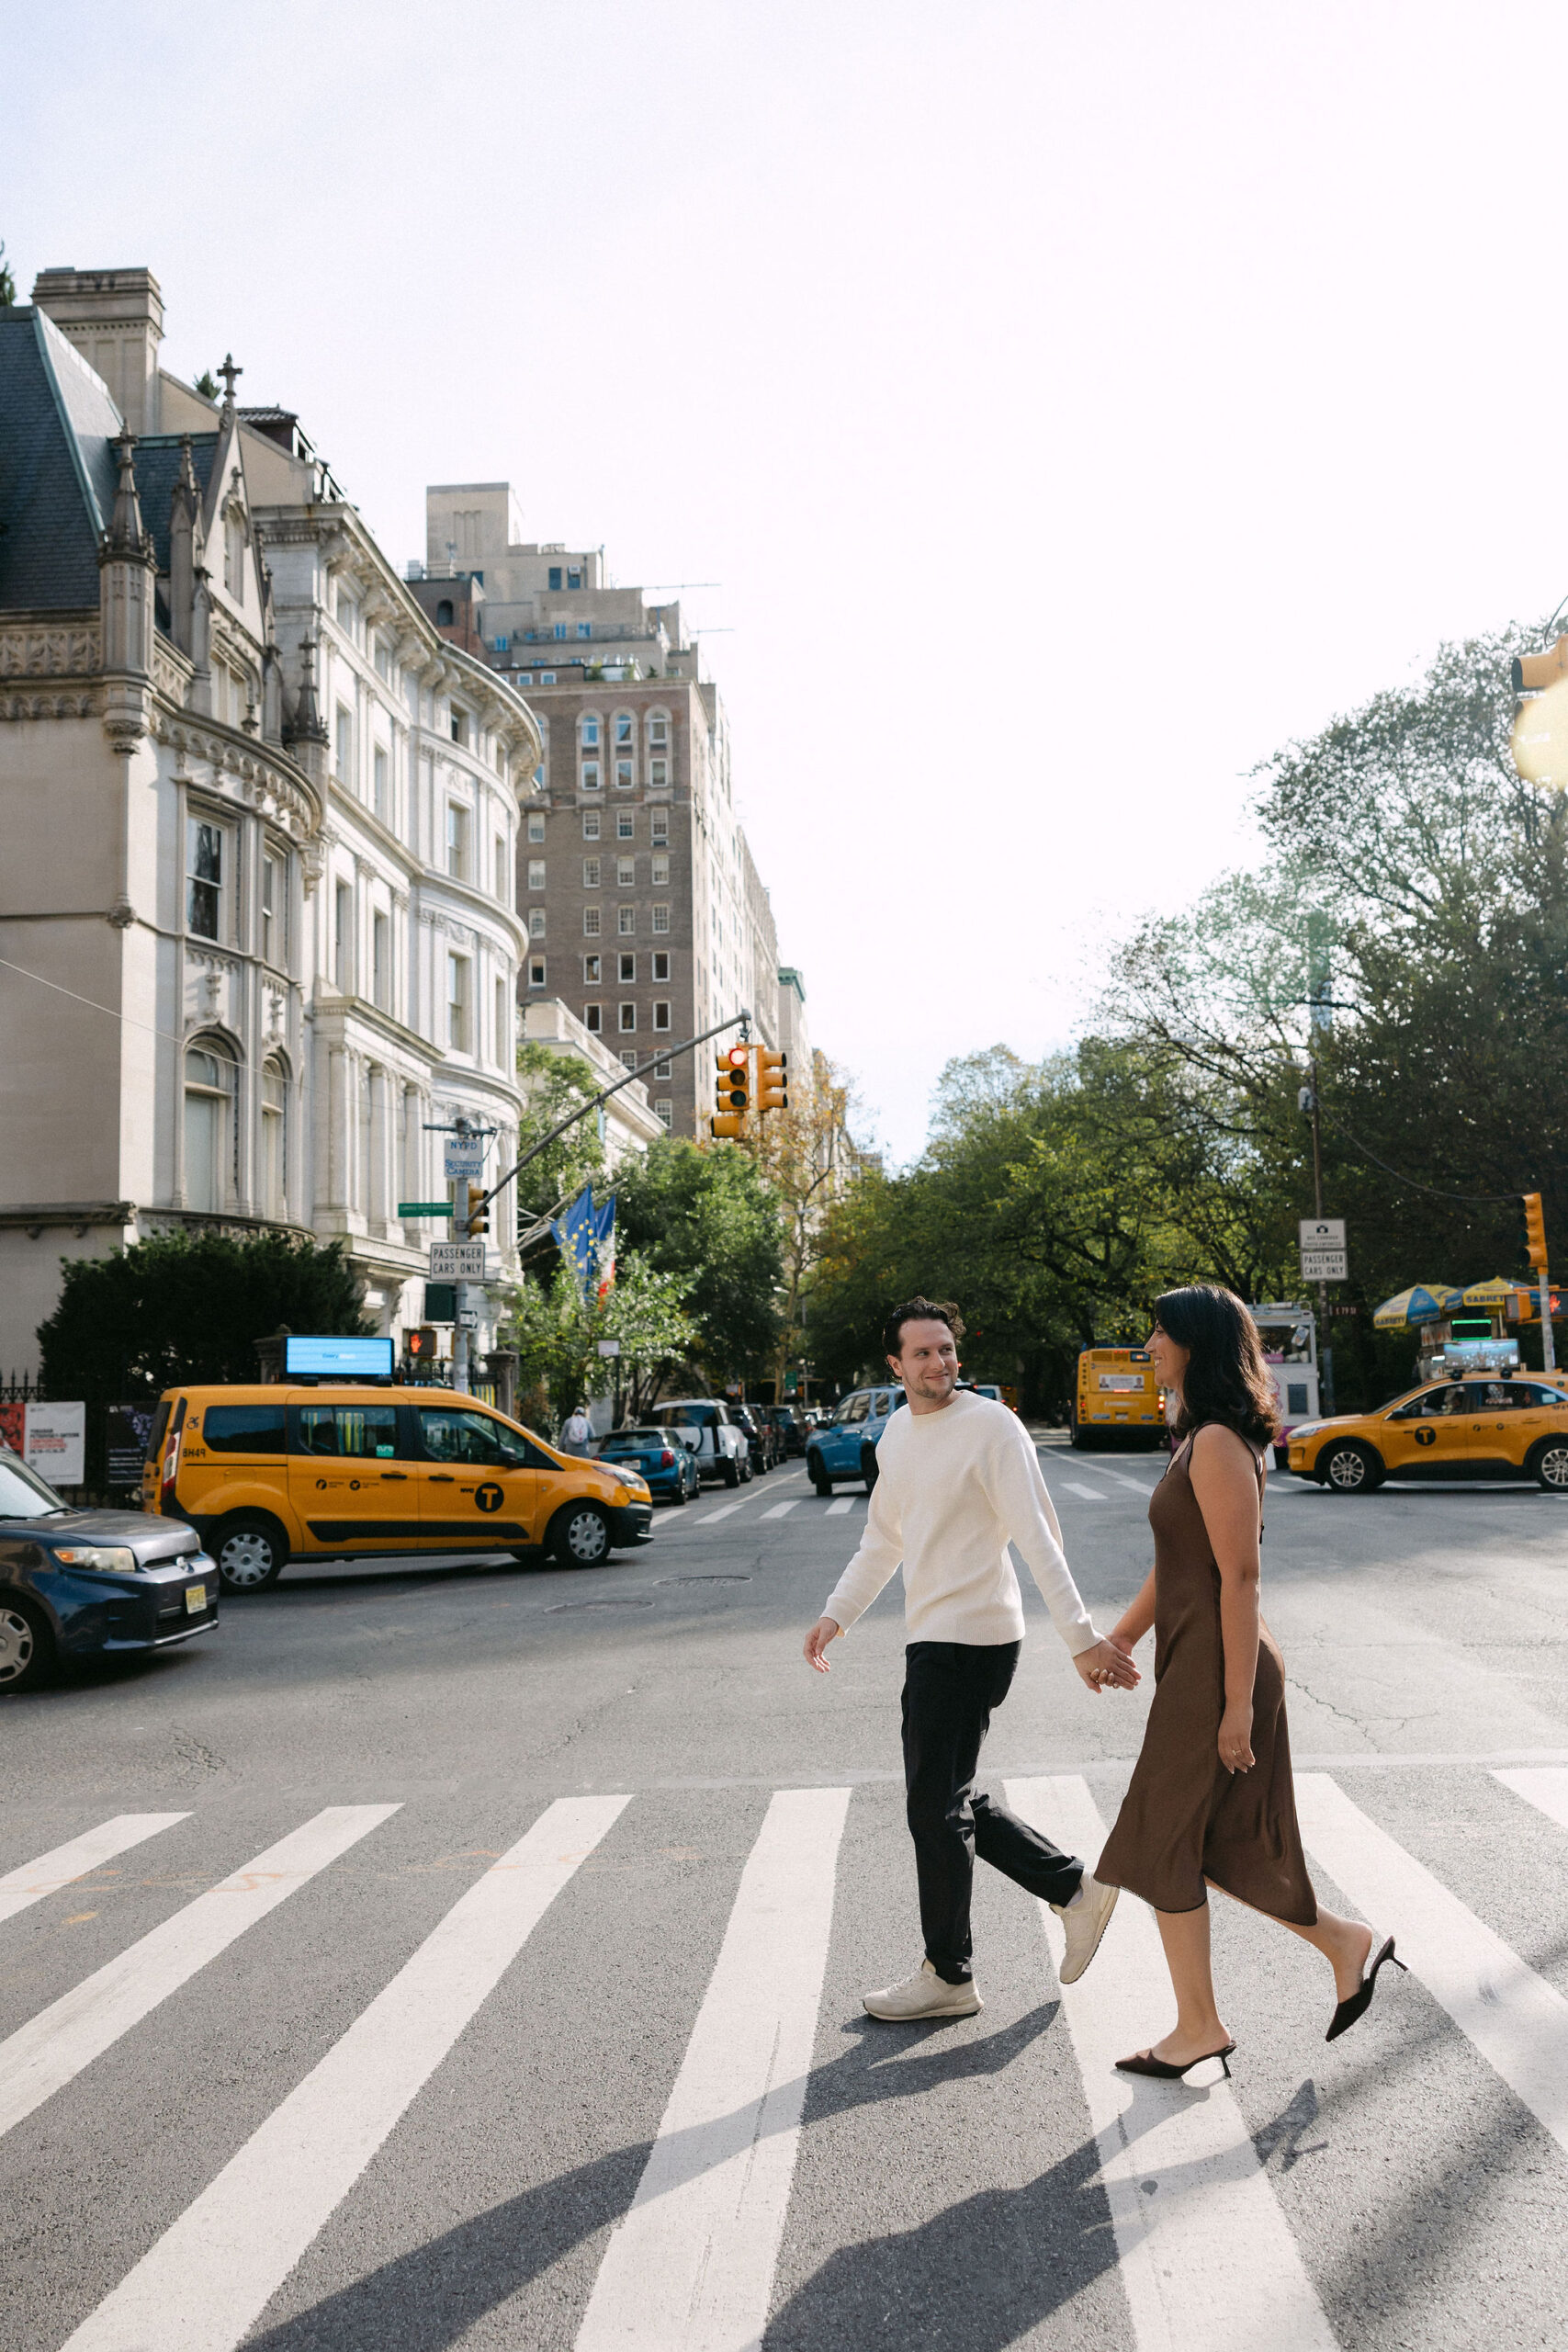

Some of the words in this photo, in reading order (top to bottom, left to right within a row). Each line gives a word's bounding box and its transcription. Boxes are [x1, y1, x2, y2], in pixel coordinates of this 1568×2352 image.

[450, 1141, 478, 1149] NYPD
[445, 1159, 481, 1168] SECURITY
[446, 1167, 479, 1175] CAMERA
[434, 1248, 481, 1259] PASSENGER
[1304, 1254, 1344, 1264] PASSENGER
[433, 1262, 455, 1273] CARS
[460, 1262, 480, 1273] ONLY
[1304, 1266, 1323, 1275] CARS
[1326, 1266, 1343, 1274] ONLY
[481, 1487, 498, 1509] T
